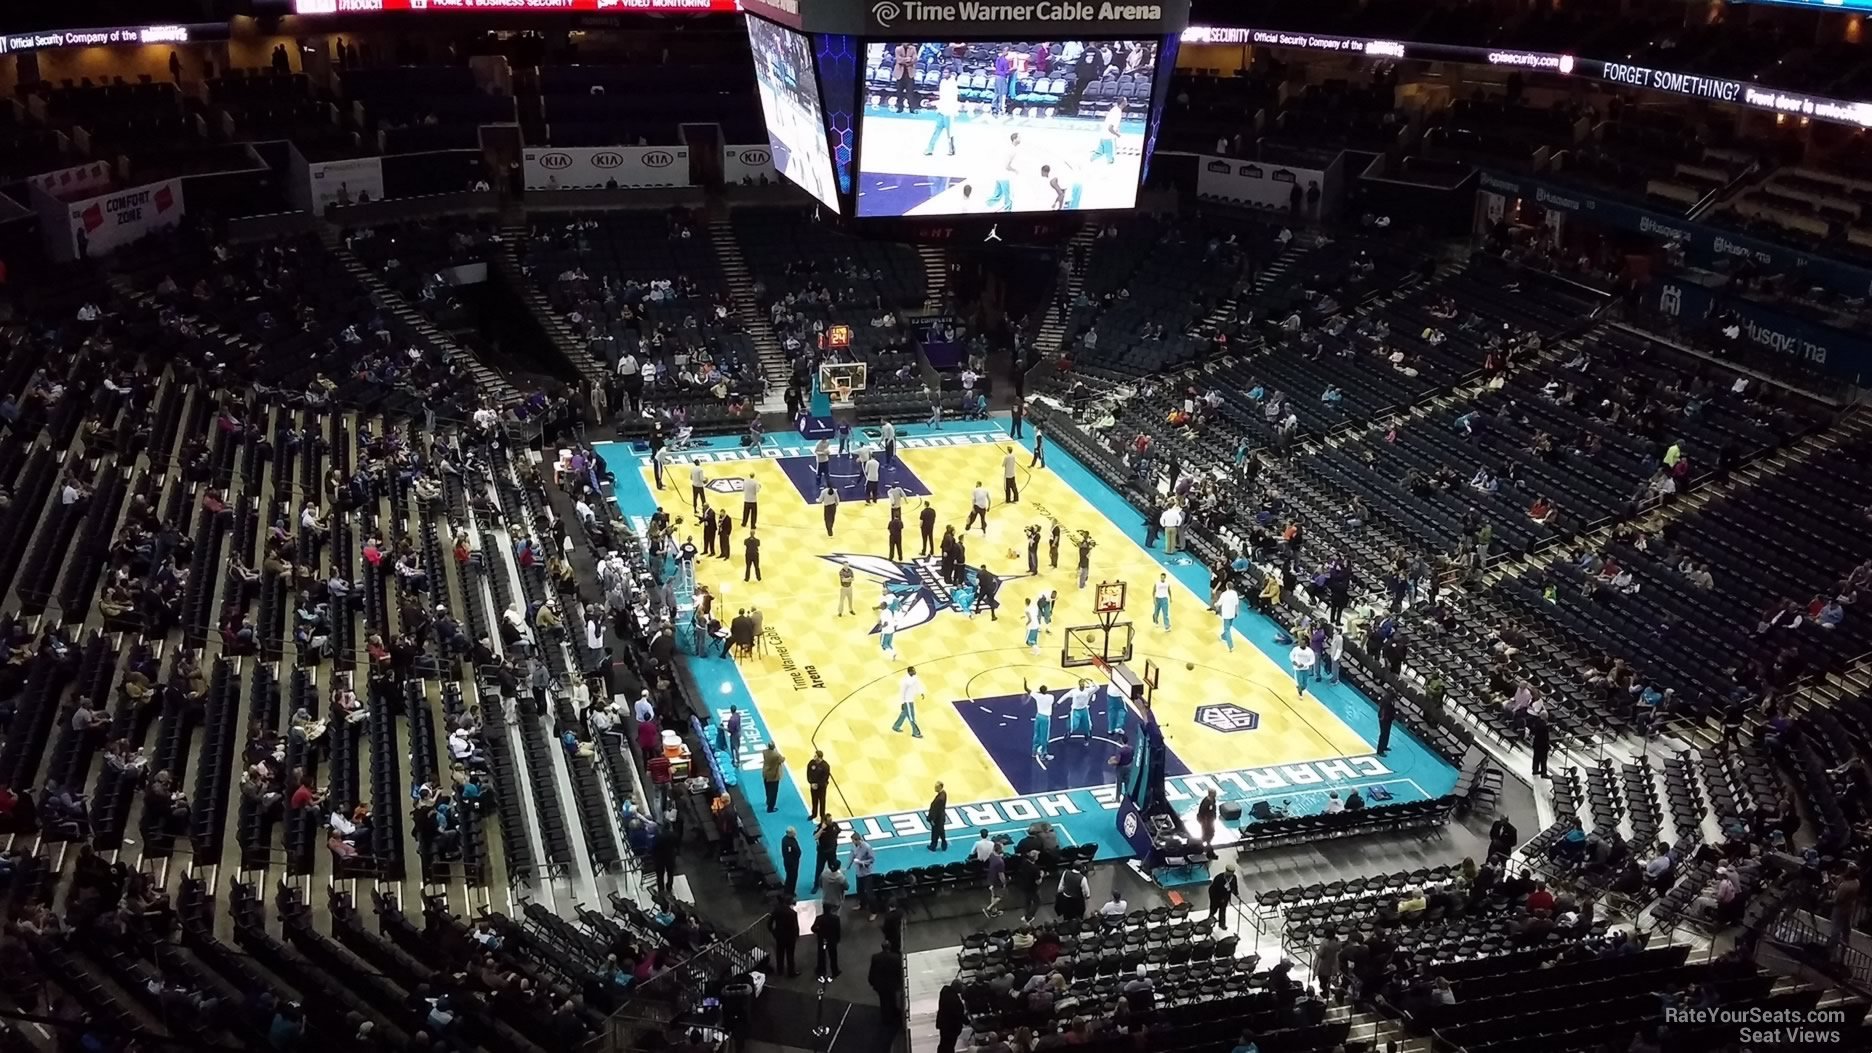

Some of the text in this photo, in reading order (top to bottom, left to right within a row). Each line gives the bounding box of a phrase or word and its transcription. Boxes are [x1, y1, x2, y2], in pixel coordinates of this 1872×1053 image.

[902, 1, 1161, 21] Time Warner Cable Arena
[10, 36, 34, 50] Official
[36, 34, 63, 50] Security
[65, 32, 109, 48] Company
[110, 30, 120, 42] of
[122, 29, 137, 41] the
[1211, 28, 1250, 43] SECURITY
[1254, 32, 1278, 44] Official
[1279, 34, 1306, 48] Security
[1308, 36, 1340, 51] Company
[1342, 39, 1350, 50] of
[1351, 40, 1364, 51] the
[1489, 51, 1559, 67] cpisecurity.com
[1603, 62, 1741, 102] FORGET SOMETHING?
[1745, 88, 1775, 107] Front
[1776, 94, 1803, 112] door
[1802, 98, 1814, 114] is
[545, 157, 568, 166] KIA
[597, 156, 619, 165] KIA
[647, 155, 668, 164] KIA
[745, 153, 764, 162] KIA
[106, 190, 150, 213] COMFORT
[117, 208, 142, 225] ZONE
[775, 646, 798, 672] Warner
[790, 671, 808, 692] Time
[804, 664, 827, 689] Arena
